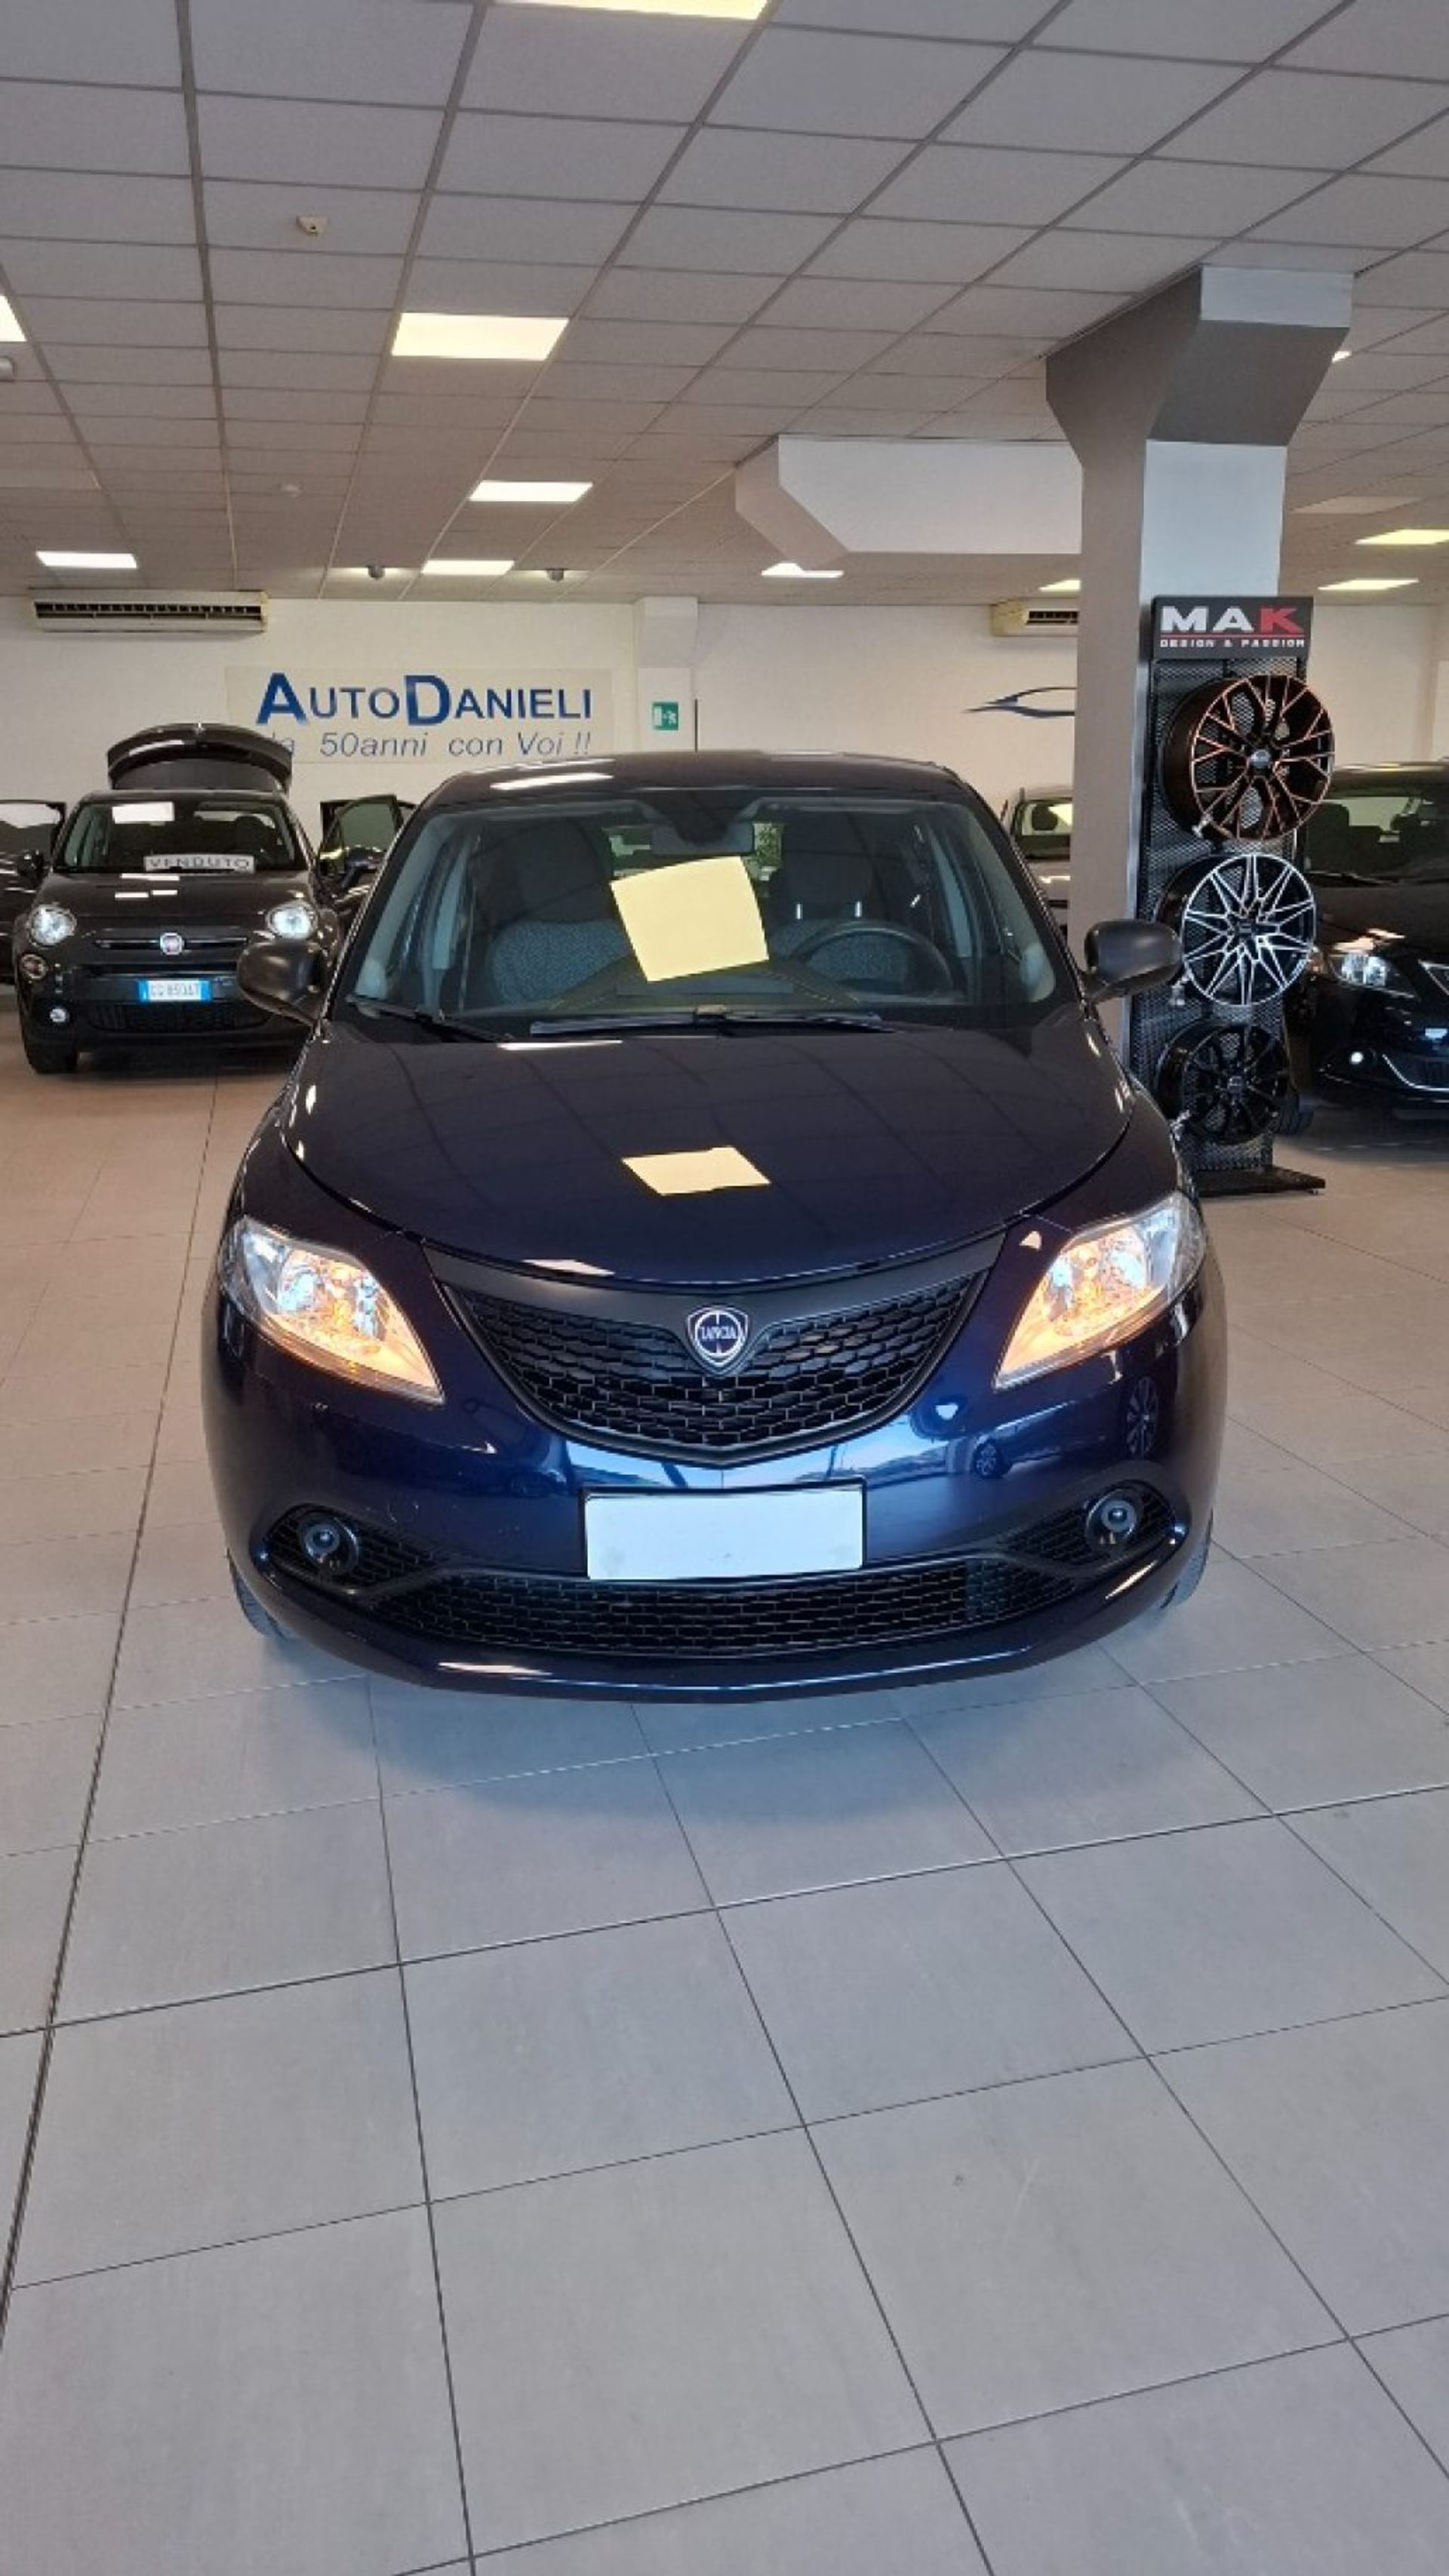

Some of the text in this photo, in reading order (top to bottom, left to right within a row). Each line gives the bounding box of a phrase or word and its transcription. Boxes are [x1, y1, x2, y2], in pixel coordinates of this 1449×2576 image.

[1160, 605, 1305, 633] MAK
[1160, 639, 1305, 648] DESIGN & PASSION
[448, 736, 503, 757] con
[518, 731, 565, 755] Voi
[151, 857, 250, 869] VENDUTO
